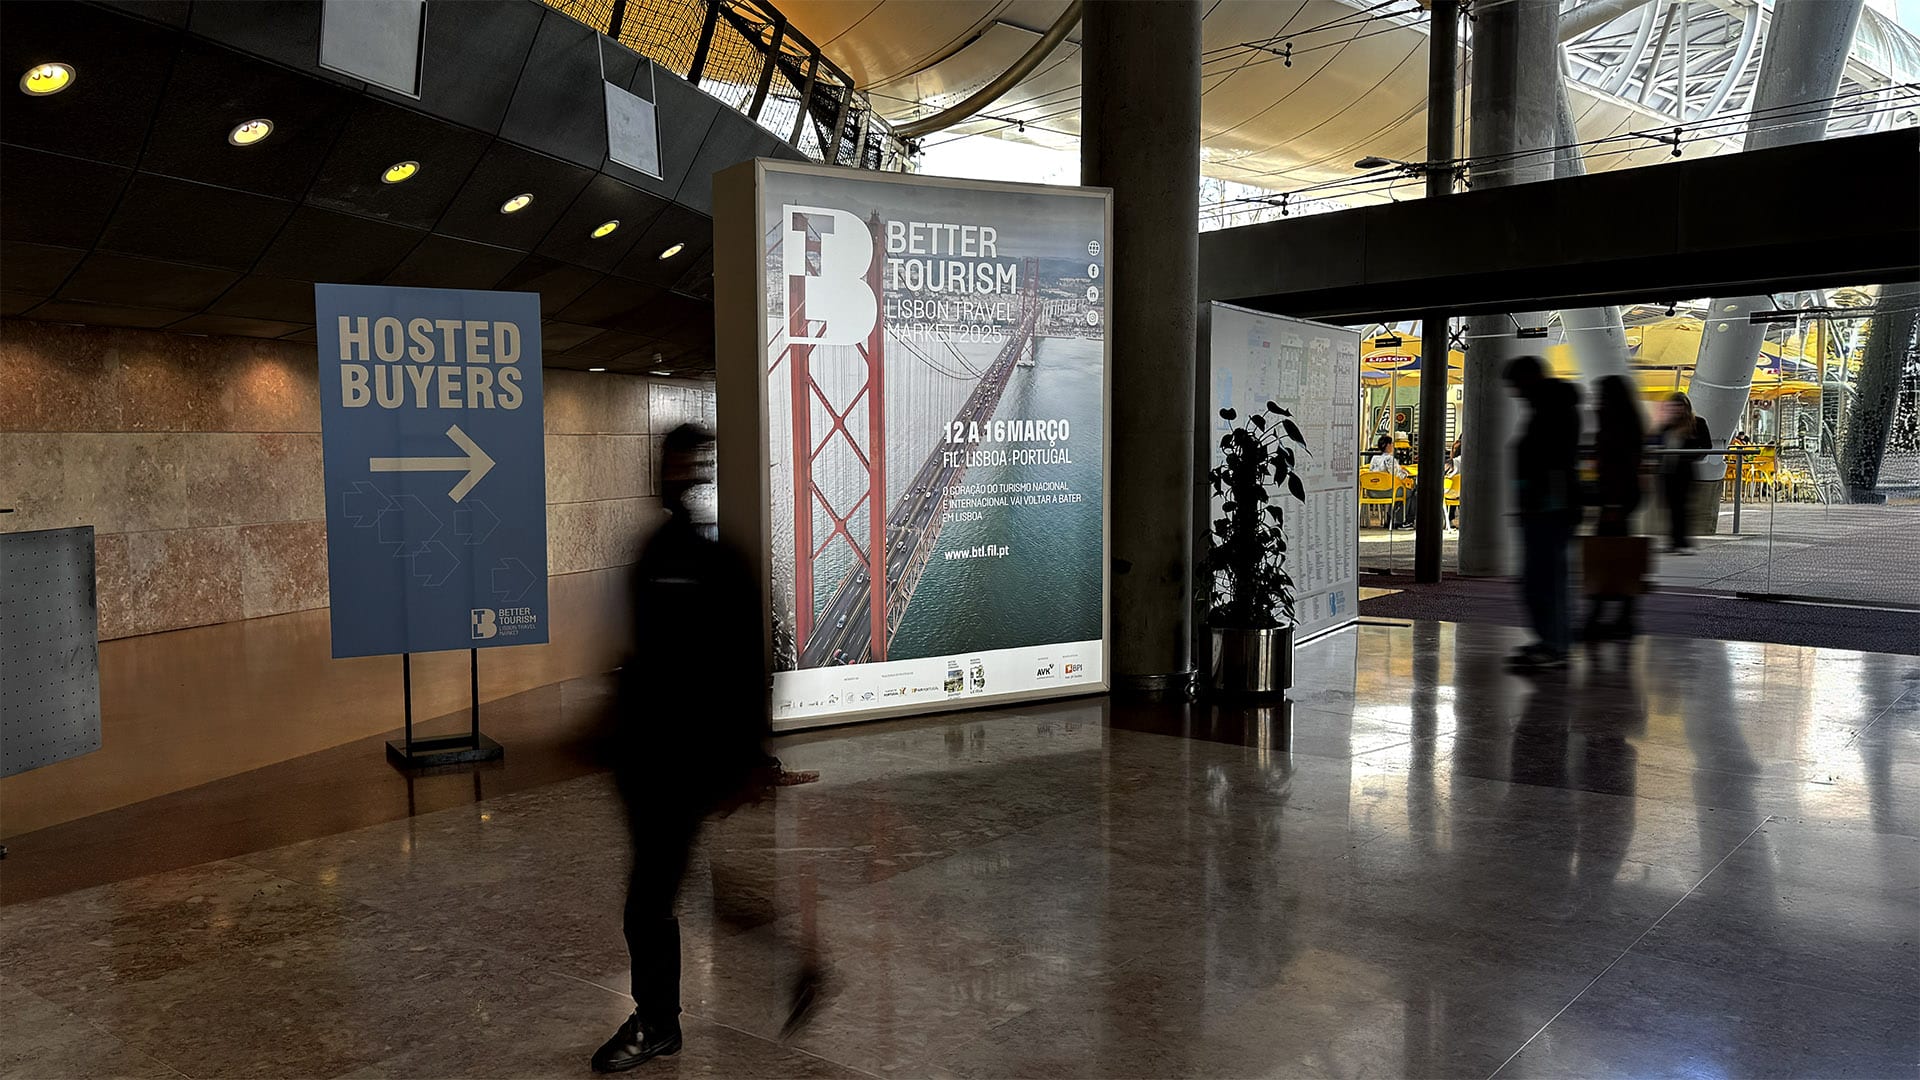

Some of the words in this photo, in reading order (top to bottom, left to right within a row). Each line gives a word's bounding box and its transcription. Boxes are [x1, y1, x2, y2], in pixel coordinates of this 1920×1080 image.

[887, 220, 997, 258] BETTER
[887, 258, 1017, 295] TOURISM
[887, 299, 949, 320] LISBON
[953, 301, 1016, 322] TRAVEL
[338, 316, 521, 364] HOSTED
[887, 323, 956, 343] MARKET
[960, 324, 1002, 344] 2025
[1369, 355, 1408, 363] Lipton
[340, 363, 523, 410] BUYERS
[943, 421, 964, 444] 12
[968, 421, 979, 443] A
[984, 420, 1005, 443] 16
[1007, 419, 1070, 447] MARÇO
[943, 487, 949, 496] O
[950, 484, 986, 497] CORAÇÃO
[987, 484, 998, 494] DO
[999, 483, 1032, 493] TURISMO
[1032, 481, 1069, 492] NACIONAL
[943, 500, 948, 509] E
[950, 498, 1009, 509] INTERNACIONAL
[1010, 496, 1022, 506] VAI
[1023, 495, 1051, 505] VOLTAR
[1052, 494, 1058, 503] A
[1058, 493, 1082, 504] BATER
[943, 513, 954, 523] EM
[955, 511, 983, 522] LISBOA
[944, 544, 1010, 560] www.btl.fil.pt
[498, 607, 531, 617] BETTER
[499, 614, 537, 625] TOURISM
[1072, 663, 1083, 672] BPI
